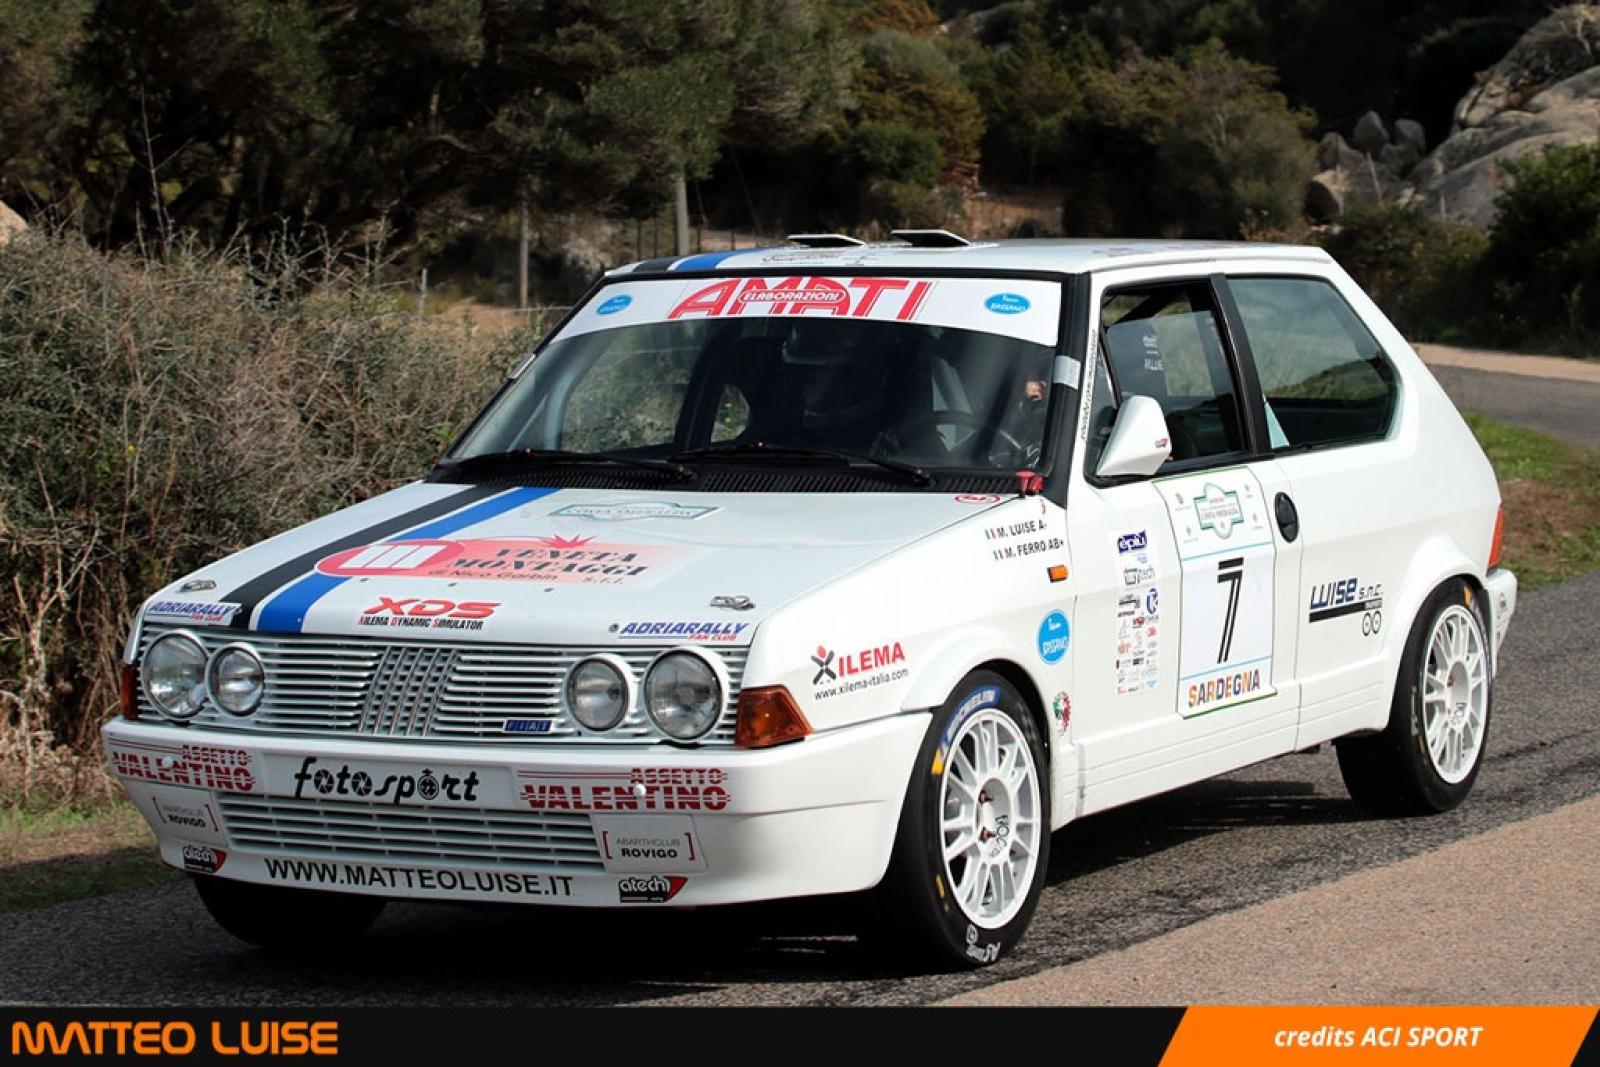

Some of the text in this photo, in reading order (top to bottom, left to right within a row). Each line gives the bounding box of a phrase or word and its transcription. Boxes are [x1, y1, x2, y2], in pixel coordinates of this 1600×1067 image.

[743, 290, 841, 302] ELABORAZIONI
[1009, 521, 1037, 537] LUISE
[1017, 541, 1047, 556] FERRO
[363, 596, 502, 619] XDS
[1217, 557, 1244, 664] 7
[620, 622, 748, 635] ADRIARALLY
[1189, 669, 1260, 707] SARDEGNA
[182, 744, 249, 766] ASSETTO
[294, 756, 479, 804] fotosport
[630, 768, 725, 785] ASSETTO
[521, 785, 729, 811] VALENTINO
[621, 848, 678, 858] ROVIGO
[264, 858, 574, 897] WWW.MATTEOLUISE.IT
